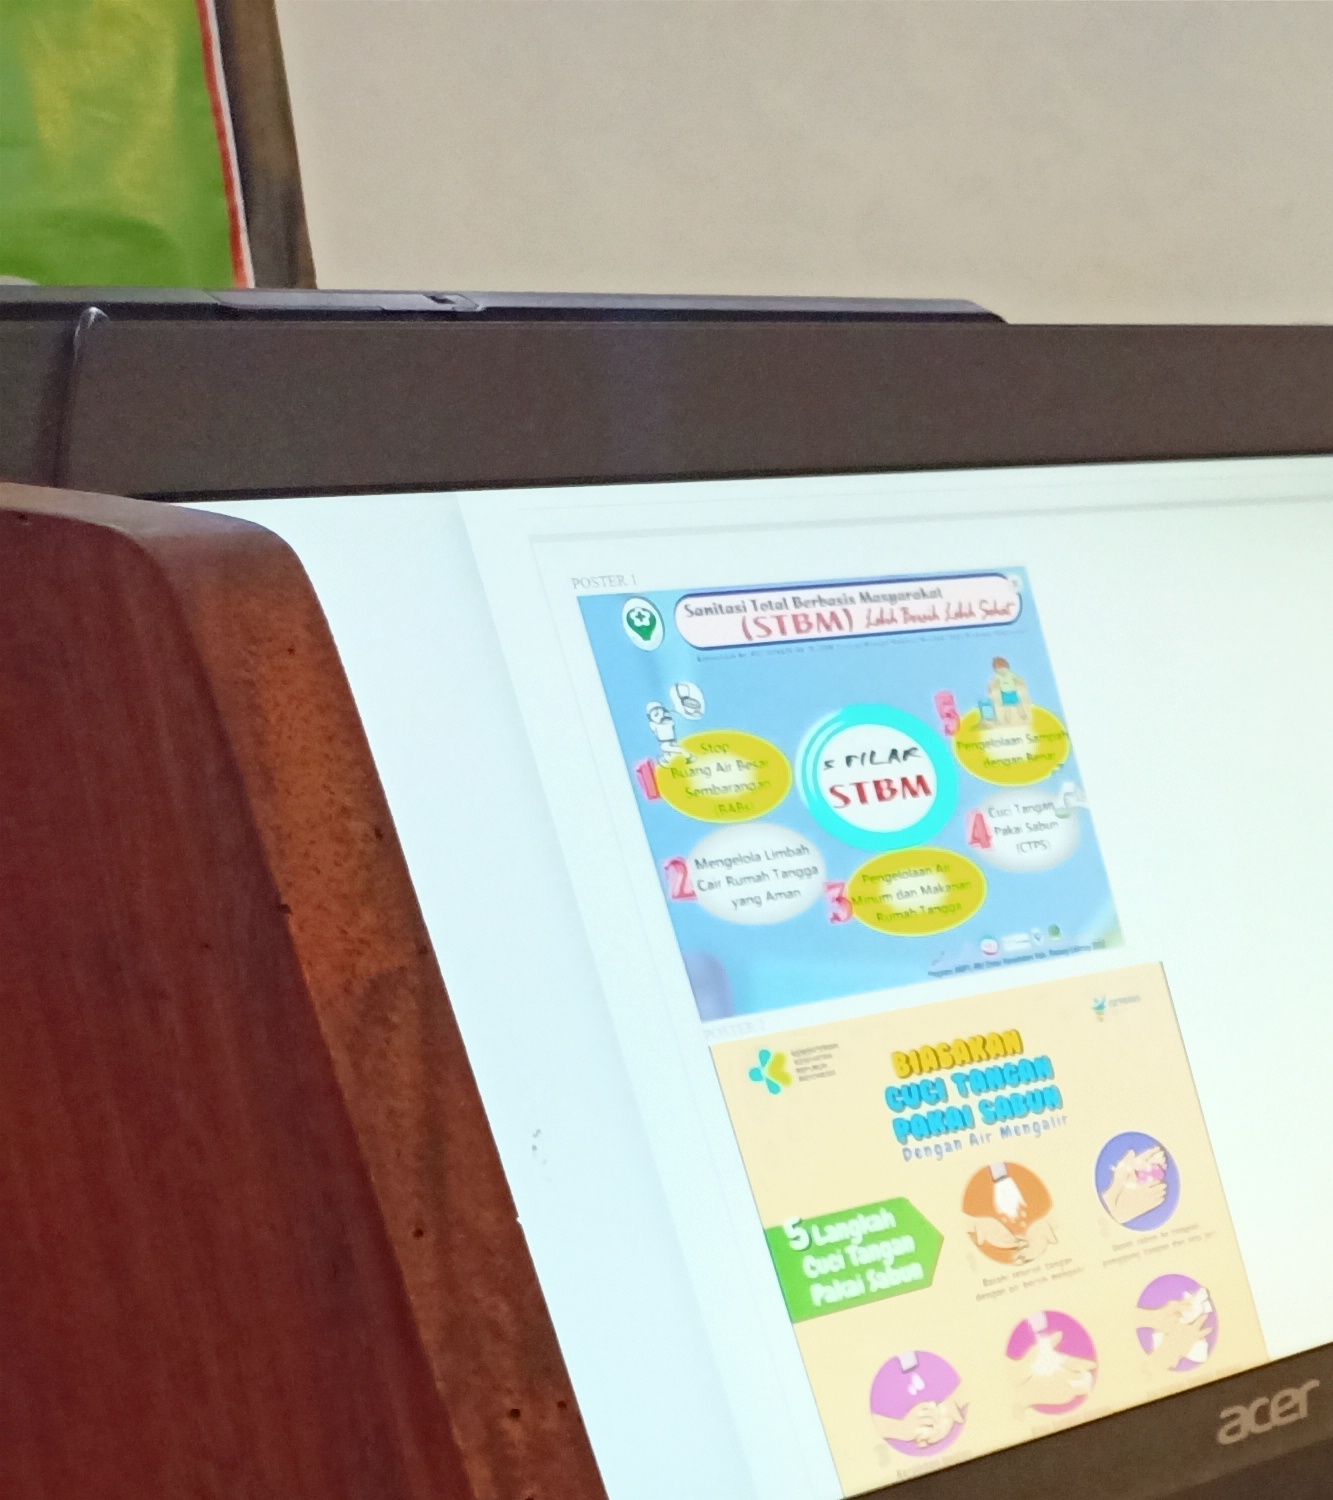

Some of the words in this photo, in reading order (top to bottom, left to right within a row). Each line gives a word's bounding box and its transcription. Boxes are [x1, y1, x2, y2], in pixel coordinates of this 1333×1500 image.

[572, 574, 629, 590] POSTER
[684, 600, 748, 618] Sanitasi
[750, 597, 789, 612] Total
[791, 593, 857, 609] Berbasis
[859, 587, 944, 605] Masyarakat
[741, 607, 854, 641] (STBM)
[934, 691, 961, 737] 5
[700, 742, 730, 755] Stop
[670, 765, 712, 779] Buang
[716, 762, 732, 773] Air
[829, 774, 932, 809] STBM
[968, 809, 994, 850] 4
[694, 852, 762, 870] Mengelola
[764, 844, 810, 861] Limbah
[697, 879, 722, 892] Cair
[725, 871, 770, 887] Rumah
[773, 864, 819, 880] Tangga
[664, 856, 698, 901] 2
[896, 888, 918, 901] dan
[731, 894, 763, 912] yang
[766, 889, 802, 902] Aman
[823, 880, 855, 925] 3
[890, 1028, 1024, 1080] BIASAKAN
[885, 1077, 949, 1113] CUCI
[950, 1055, 1055, 1098] TANGAN
[892, 1104, 976, 1145] PAKAI
[978, 1084, 1064, 1126] SABUN
[902, 1138, 963, 1162] Dengan
[969, 1131, 993, 1148] Air
[999, 1114, 1069, 1139] Mengalir
[783, 1216, 812, 1251] 5
[812, 1207, 897, 1246] Langkah
[803, 1250, 846, 1279] Cuci
[845, 1234, 916, 1268] Tangan
[810, 1274, 866, 1307] Pakai
[866, 1262, 924, 1293] Sabun
[1216, 1378, 1321, 1446] acer
